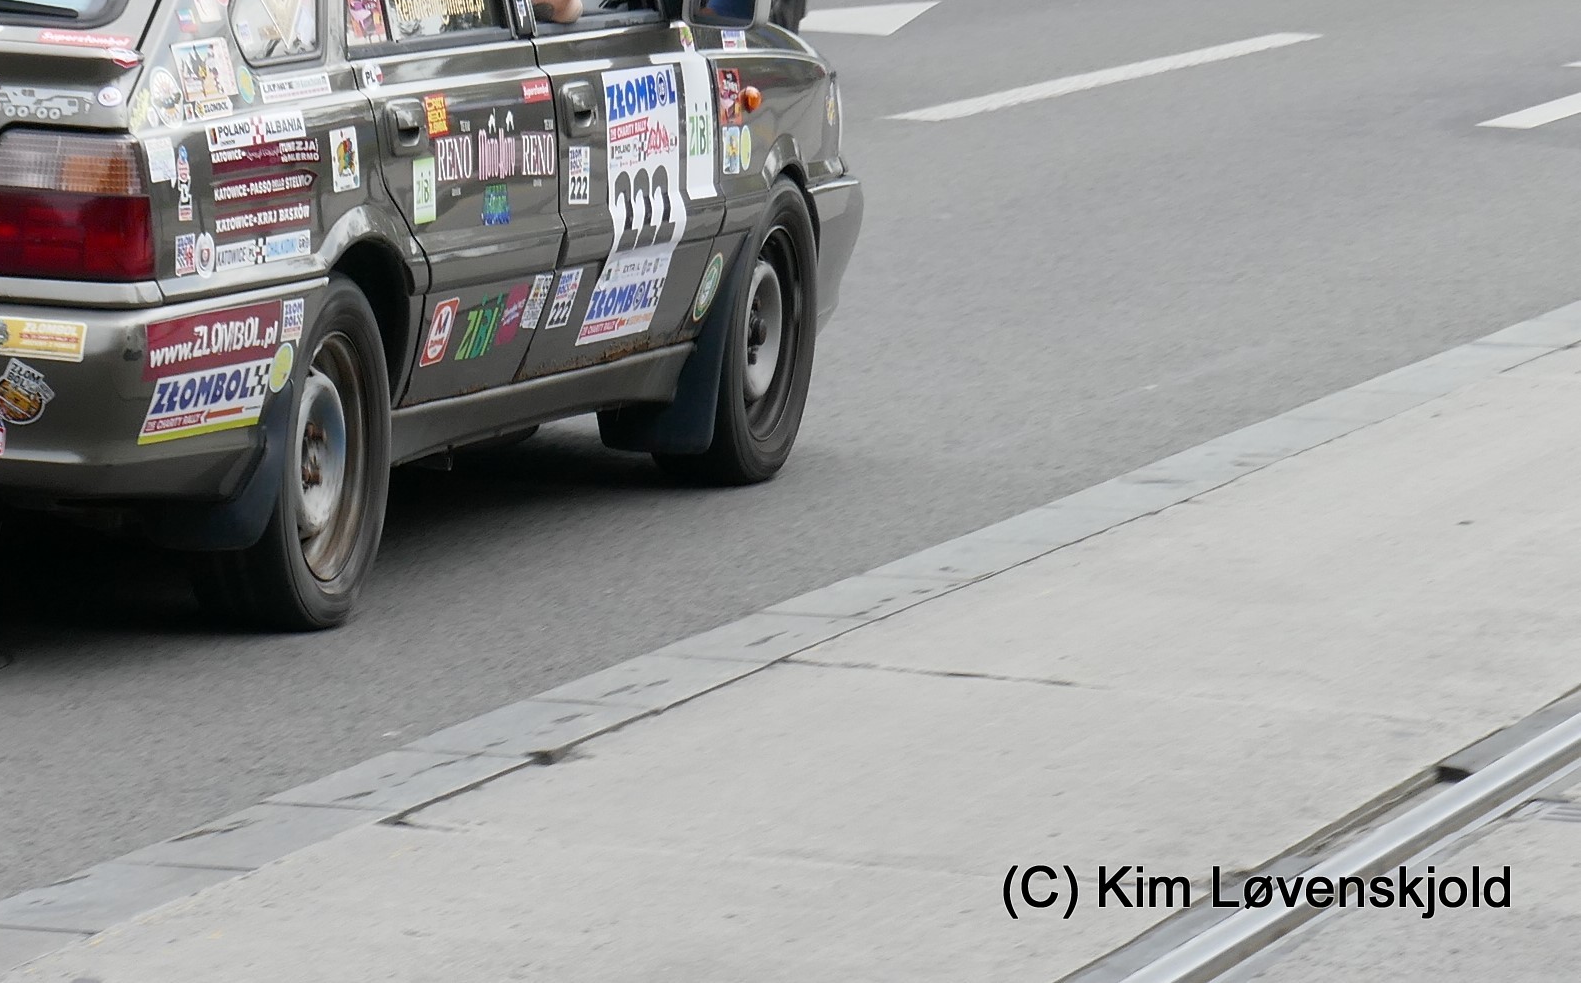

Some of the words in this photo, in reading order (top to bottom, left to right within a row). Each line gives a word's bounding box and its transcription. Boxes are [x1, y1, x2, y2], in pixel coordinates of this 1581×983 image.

[218, 121, 251, 139] POLAND
[265, 118, 304, 135] ALBANIA
[436, 135, 473, 182] RENO
[521, 133, 555, 177] RENO
[570, 176, 588, 201] 222
[614, 165, 676, 253] 222
[547, 301, 572, 327] 222
[149, 367, 252, 416] ZŁOMBOL
[156, 415, 184, 430] CHARITY
